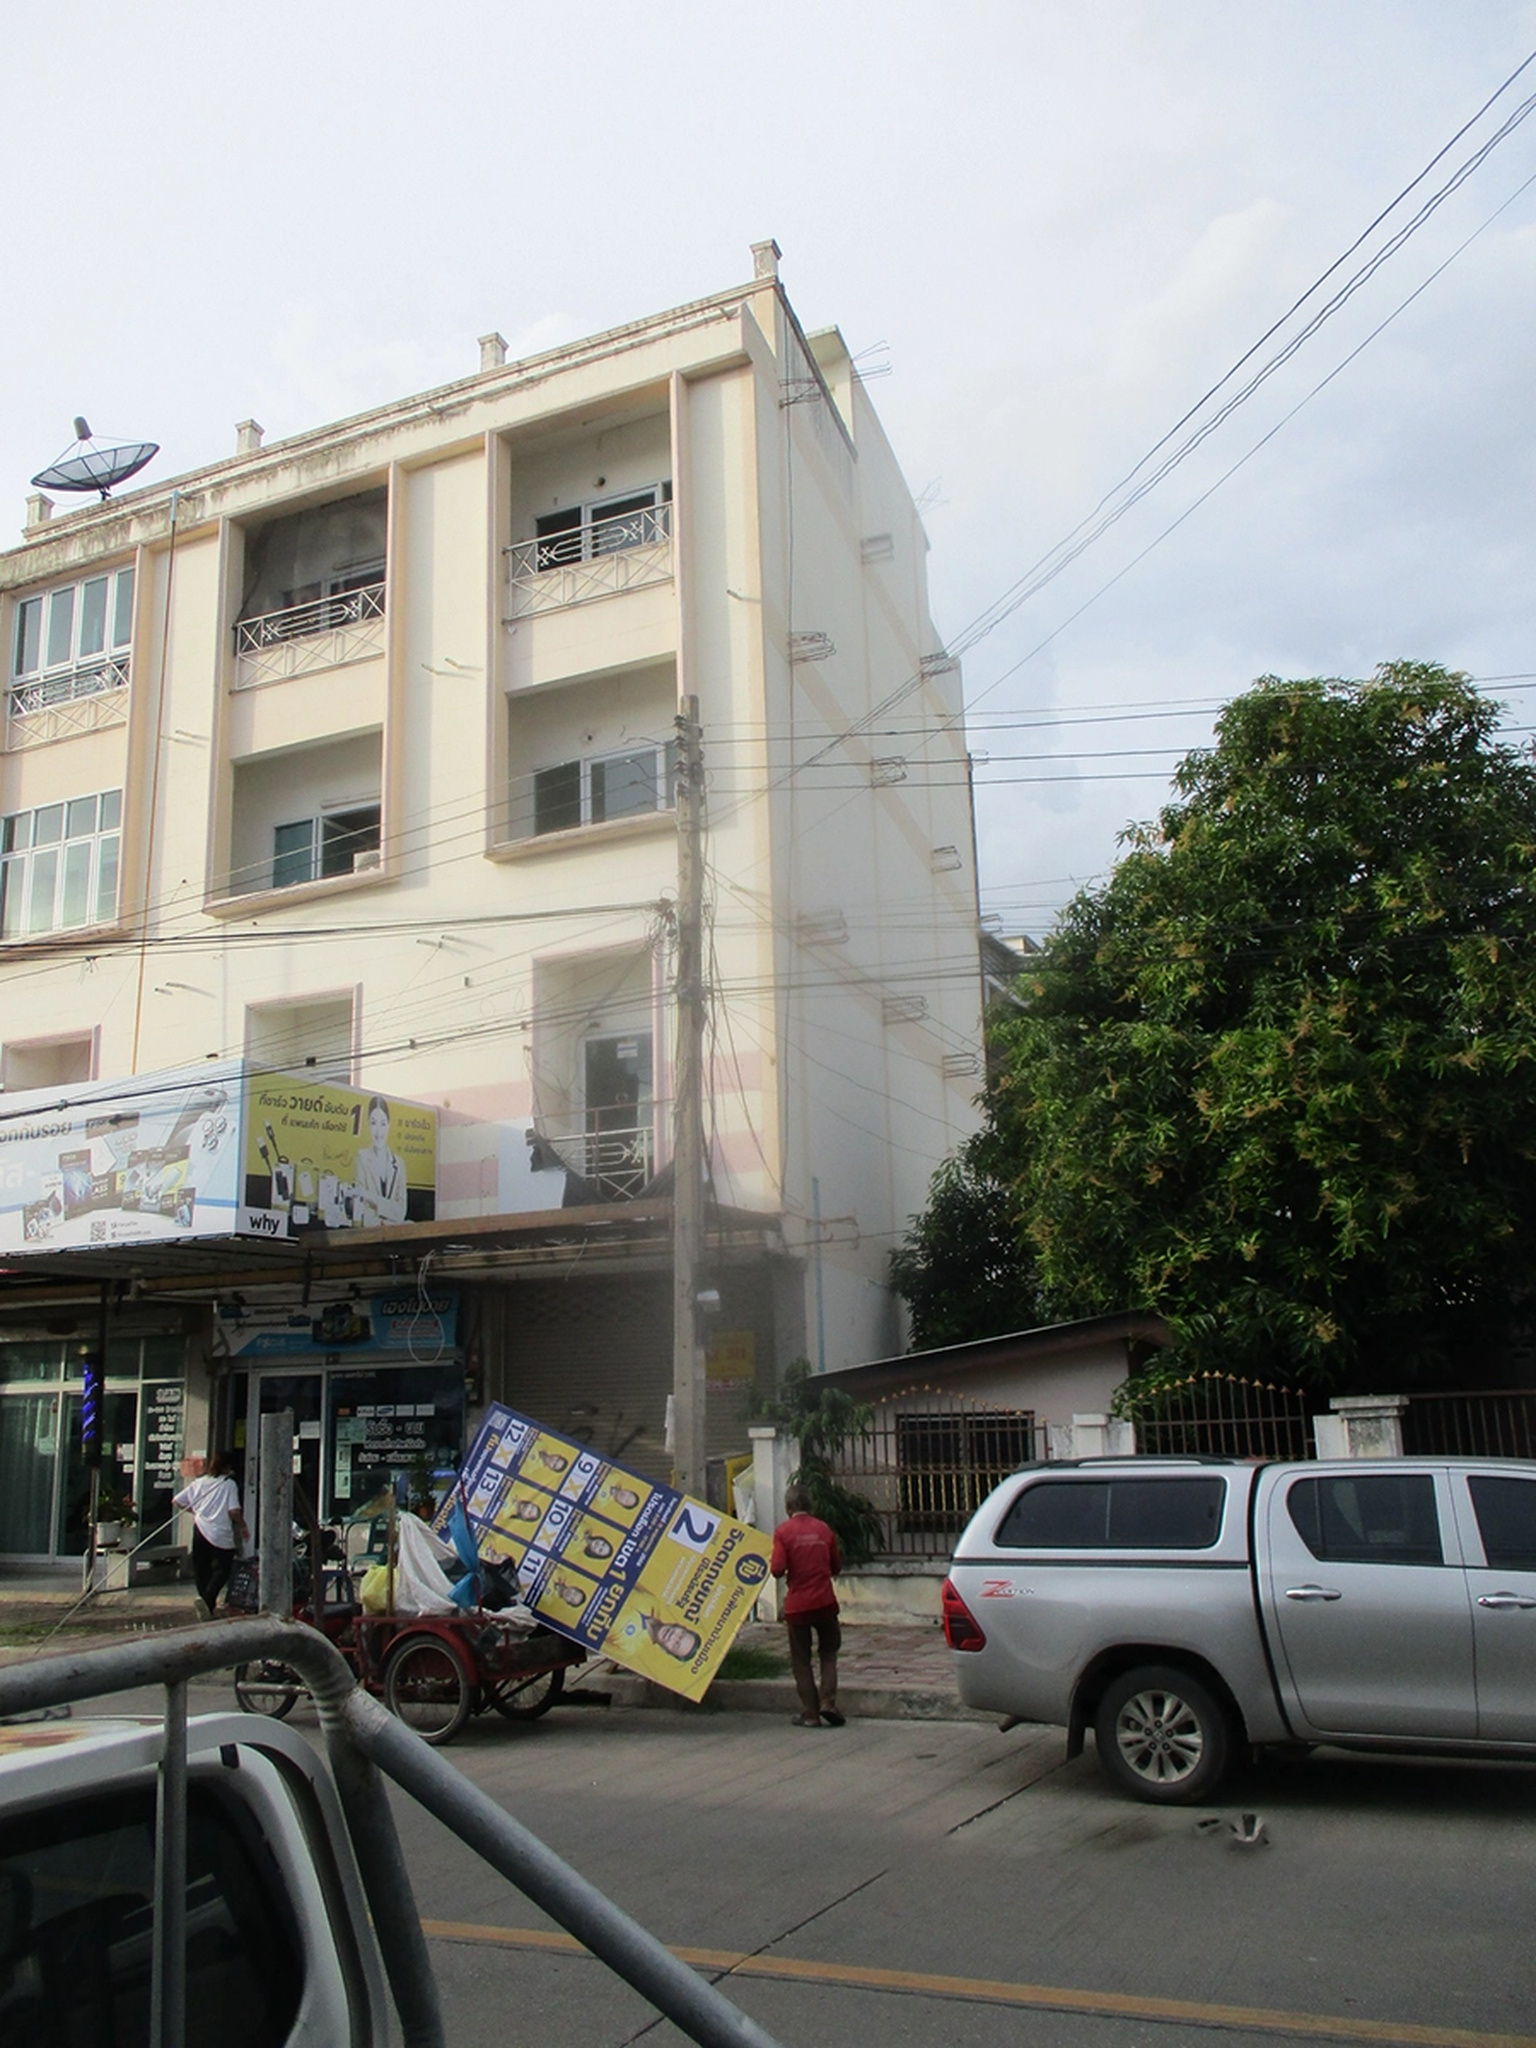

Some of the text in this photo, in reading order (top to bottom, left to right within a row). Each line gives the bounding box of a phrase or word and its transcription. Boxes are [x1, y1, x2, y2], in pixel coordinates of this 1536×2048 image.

[289, 1095, 324, 1112] วายด์
[351, 1104, 362, 1135] 1
[249, 1214, 280, 1235] why
[505, 1421, 526, 1445] 12
[576, 1458, 595, 1475] 9
[479, 1469, 501, 1494] 13
[547, 1501, 571, 1528] 10
[630, 1490, 663, 1540] โปรดเลือก
[671, 1507, 717, 1549] 2
[522, 1553, 543, 1575] 11
[613, 1538, 638, 1569] เขต
[608, 1565, 628, 1582] 1
[683, 1526, 746, 1626] จิตตเกษมณ์
[584, 1581, 630, 1644] ยกทีม
